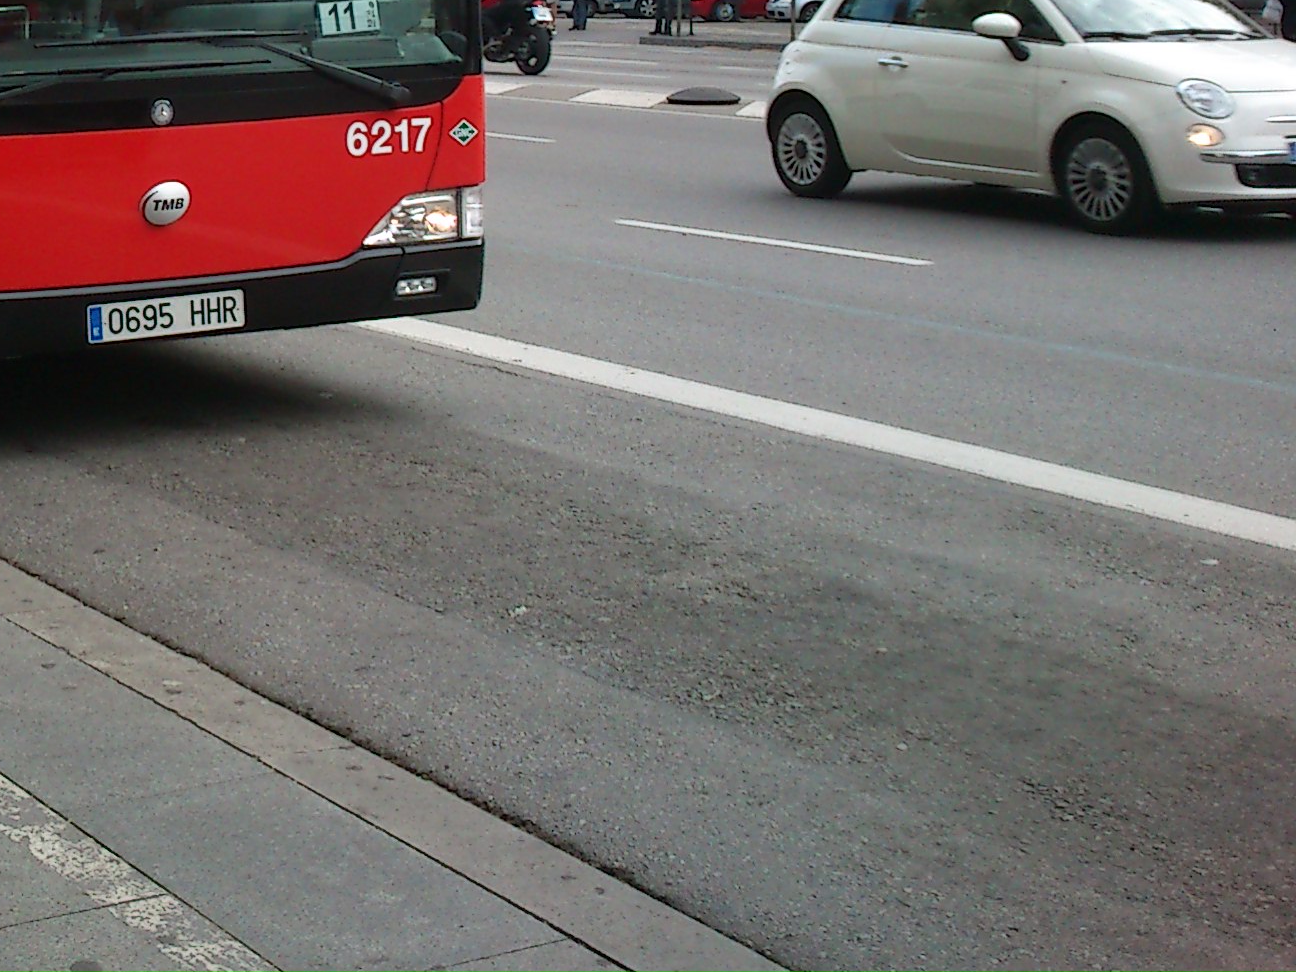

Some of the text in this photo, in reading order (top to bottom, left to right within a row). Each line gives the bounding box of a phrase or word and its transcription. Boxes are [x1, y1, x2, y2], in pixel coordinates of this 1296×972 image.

[328, 2, 357, 32] 11
[346, 117, 432, 157] 6217
[153, 198, 184, 211] TMB
[108, 296, 238, 335] 0695 HHR
